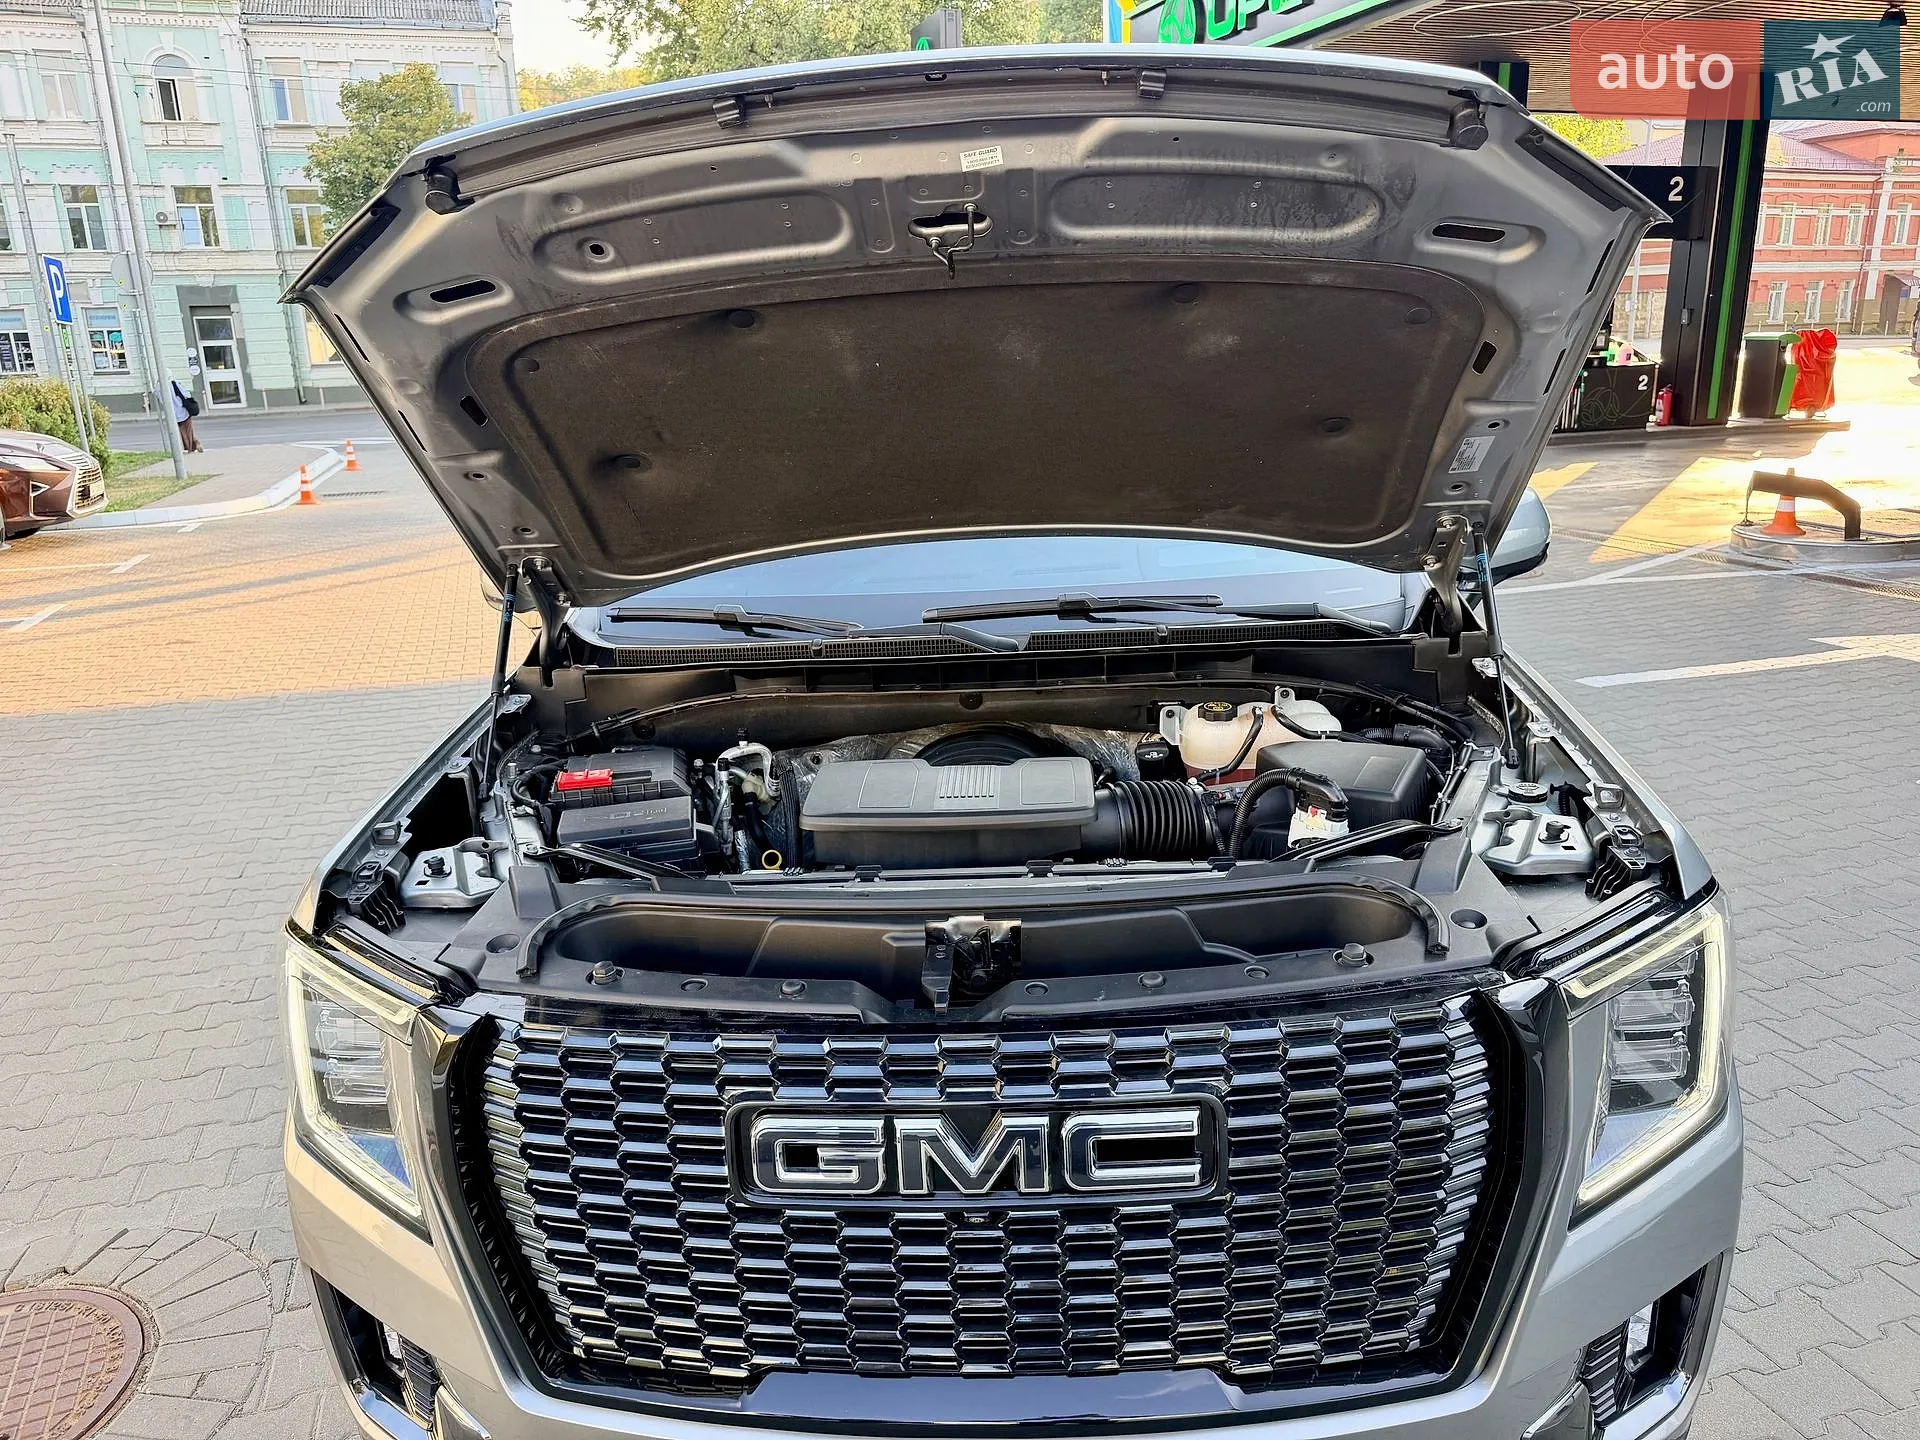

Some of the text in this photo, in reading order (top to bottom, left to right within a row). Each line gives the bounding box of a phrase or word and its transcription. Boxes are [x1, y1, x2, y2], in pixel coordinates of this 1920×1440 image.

[1668, 176, 1684, 201] 2
[48, 264, 64, 316] P
[1637, 374, 1649, 391] 2
[751, 1107, 1200, 1195] GMC
